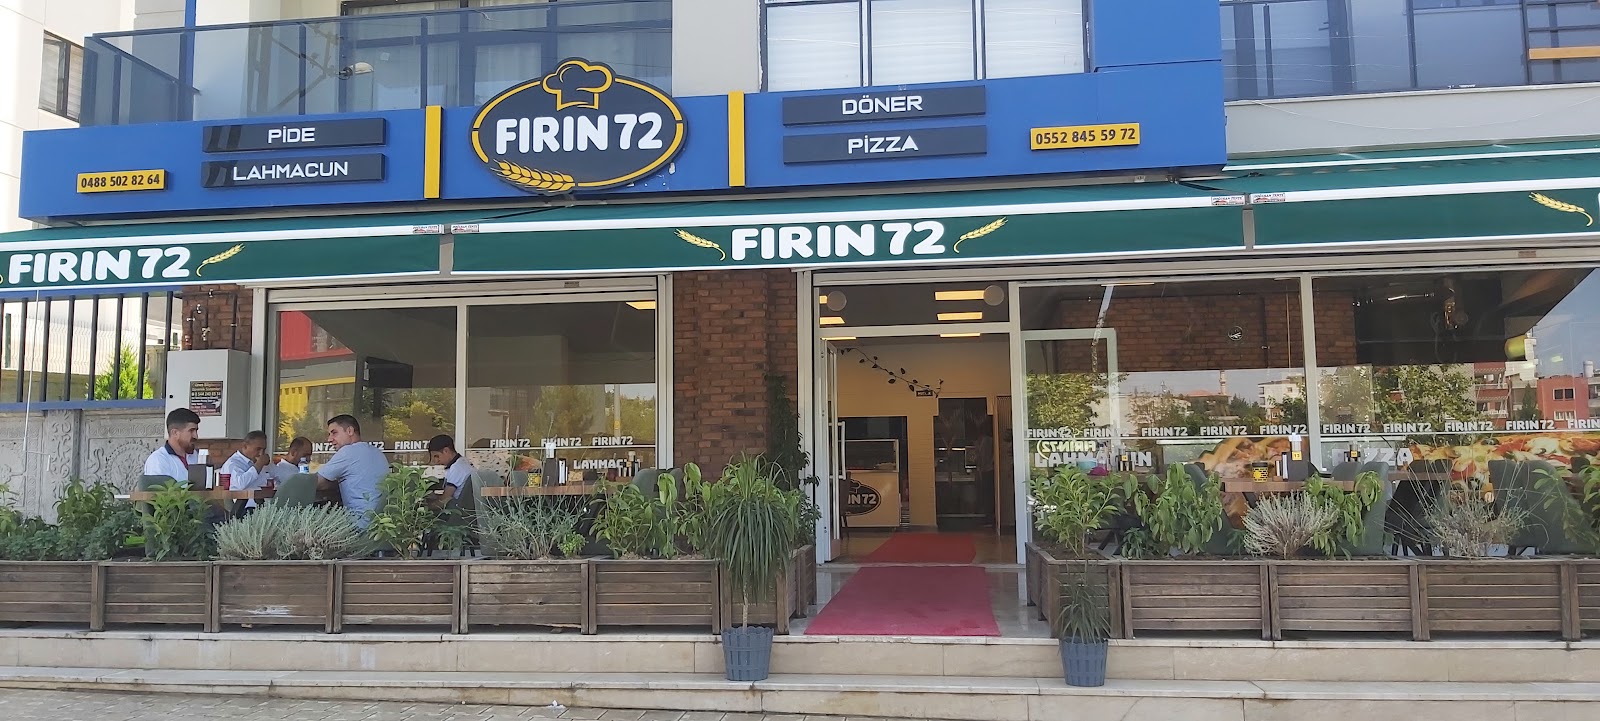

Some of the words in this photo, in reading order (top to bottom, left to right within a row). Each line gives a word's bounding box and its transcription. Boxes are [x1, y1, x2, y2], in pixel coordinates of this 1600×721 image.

[842, 95, 923, 115] DÖNER
[268, 125, 316, 144] PİDE
[496, 114, 609, 155] FIRIN
[614, 112, 663, 150] 72
[1035, 131, 1068, 145] 0552
[1072, 130, 1096, 143] 845
[1100, 129, 1117, 142] 59
[1120, 127, 1136, 140] 72
[848, 134, 919, 154] PİZZA
[233, 161, 349, 181] LAHMACUN
[81, 175, 107, 189] 0488
[110, 175, 128, 187] 502
[131, 174, 144, 186] 82
[147, 173, 160, 186] 64
[731, 223, 875, 261] FIRIN
[881, 220, 946, 256] 72
[8, 249, 131, 285] FIRIN
[137, 246, 191, 279] 72
[1260, 425, 1291, 434] FIRIN
[1292, 424, 1307, 433] 72
[1323, 424, 1355, 433] FIRIN
[1356, 423, 1370, 433] 72
[1383, 423, 1416, 432] FIRIN
[1418, 422, 1432, 431] 72
[1445, 421, 1477, 432] FIRIN
[1478, 421, 1493, 431] 72
[1506, 420, 1539, 430] FIRIN
[1540, 419, 1555, 429] 72
[1027, 429, 1058, 438] FIRIN
[1142, 427, 1173, 437] FIRIN
[1174, 427, 1188, 436] 72
[1200, 426, 1232, 435] FIRIN
[1234, 426, 1247, 435] 72
[394, 440, 421, 450] FIRIN
[422, 440, 430, 449] 7
[490, 439, 517, 448] FIRIN
[518, 438, 530, 447] 72
[570, 438, 582, 446] 72
[592, 437, 620, 446] FIRIN
[621, 436, 633, 445] 72
[862, 493, 877, 504] 72
